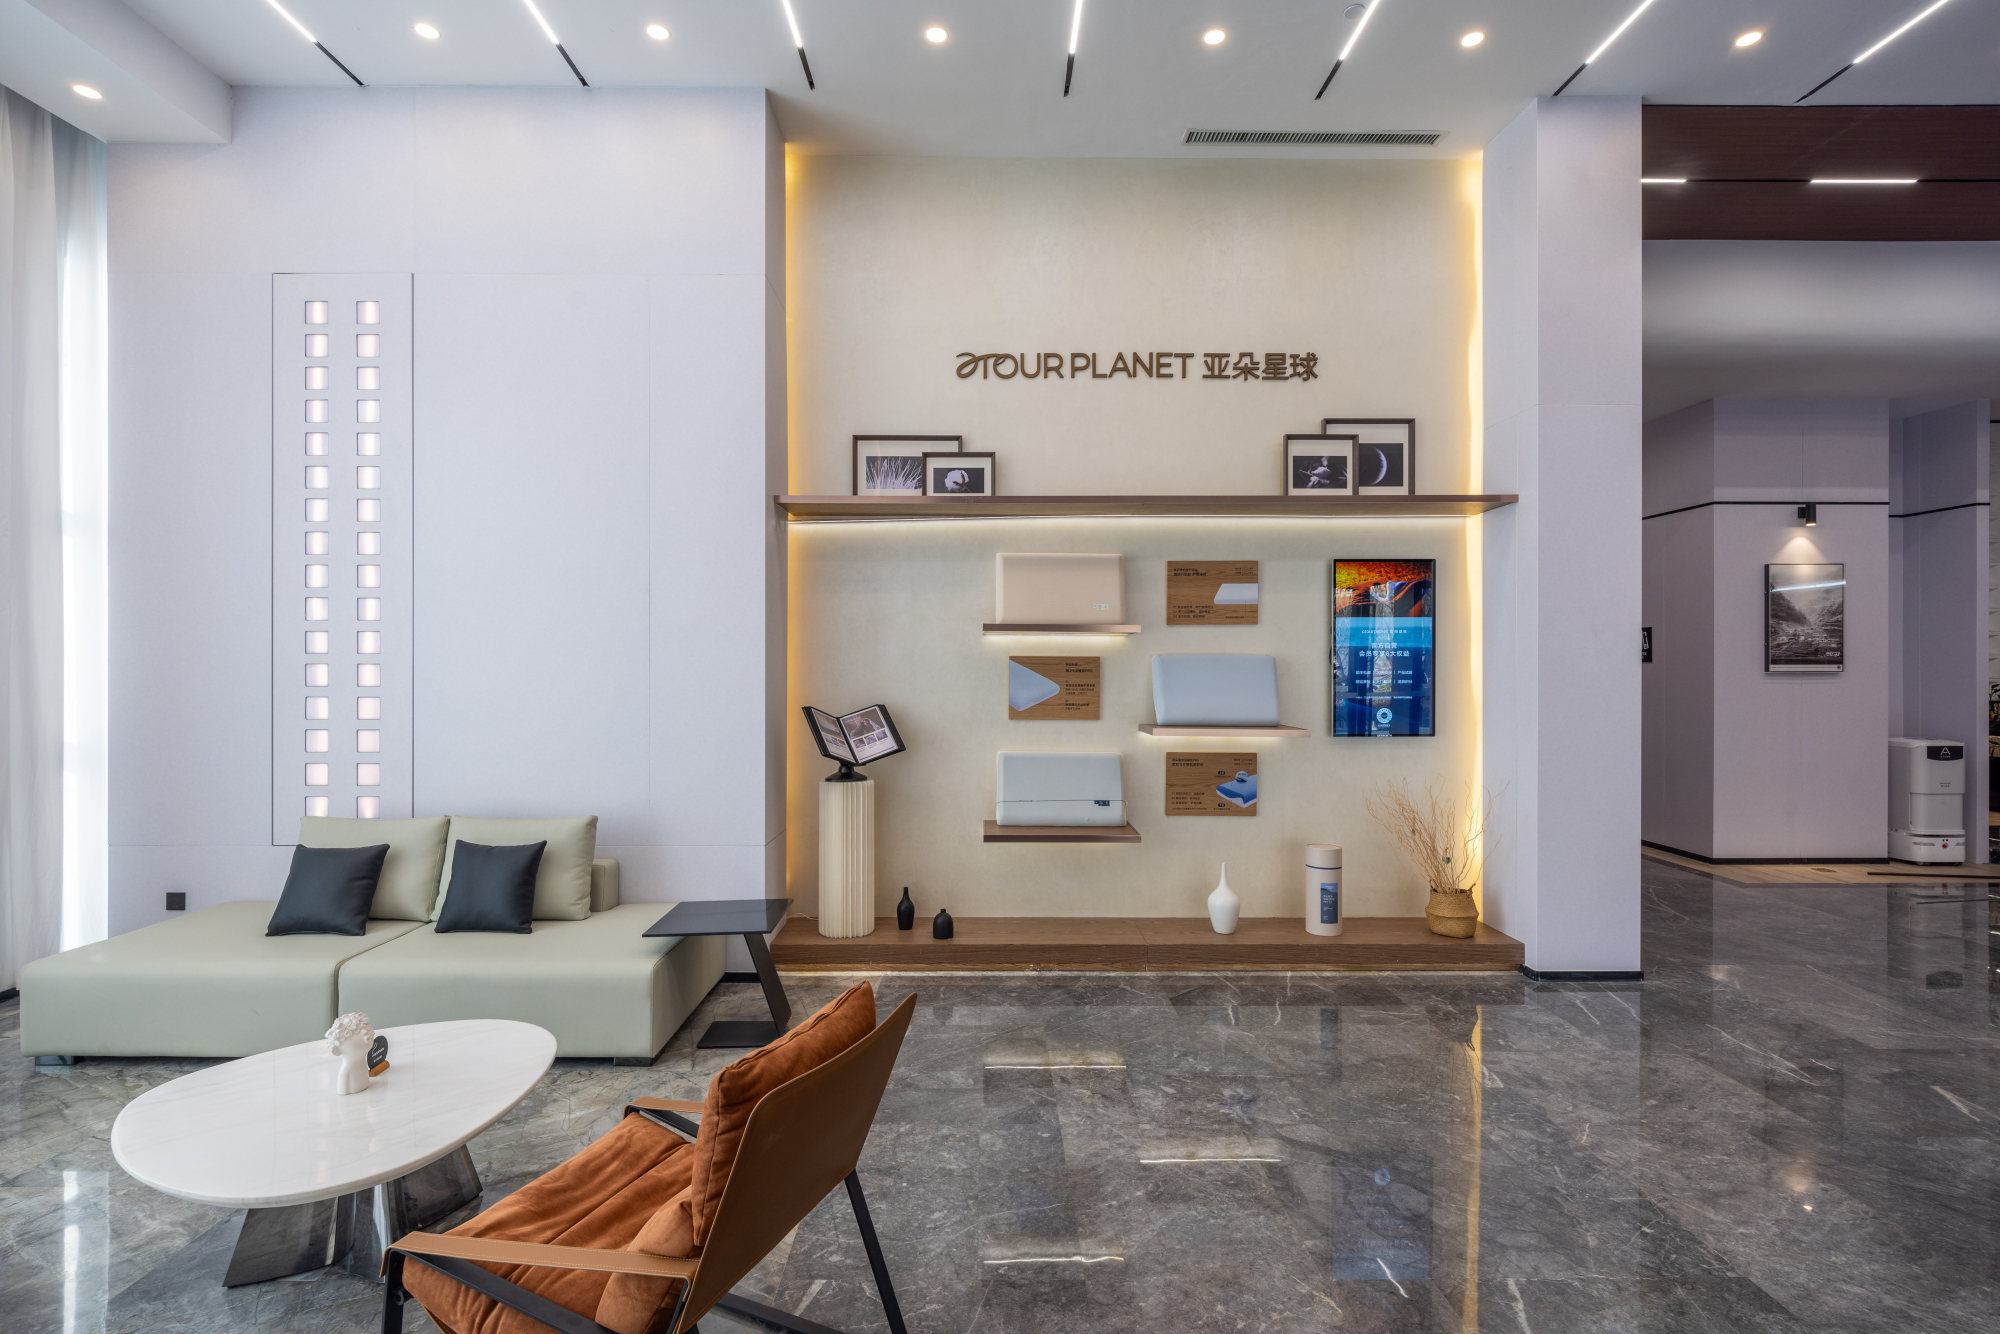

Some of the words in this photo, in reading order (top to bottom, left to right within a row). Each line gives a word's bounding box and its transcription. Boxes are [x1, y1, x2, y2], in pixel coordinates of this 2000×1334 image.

[1070, 351, 1194, 380] PLANET
[1202, 351, 1319, 382] 亚朵星球
